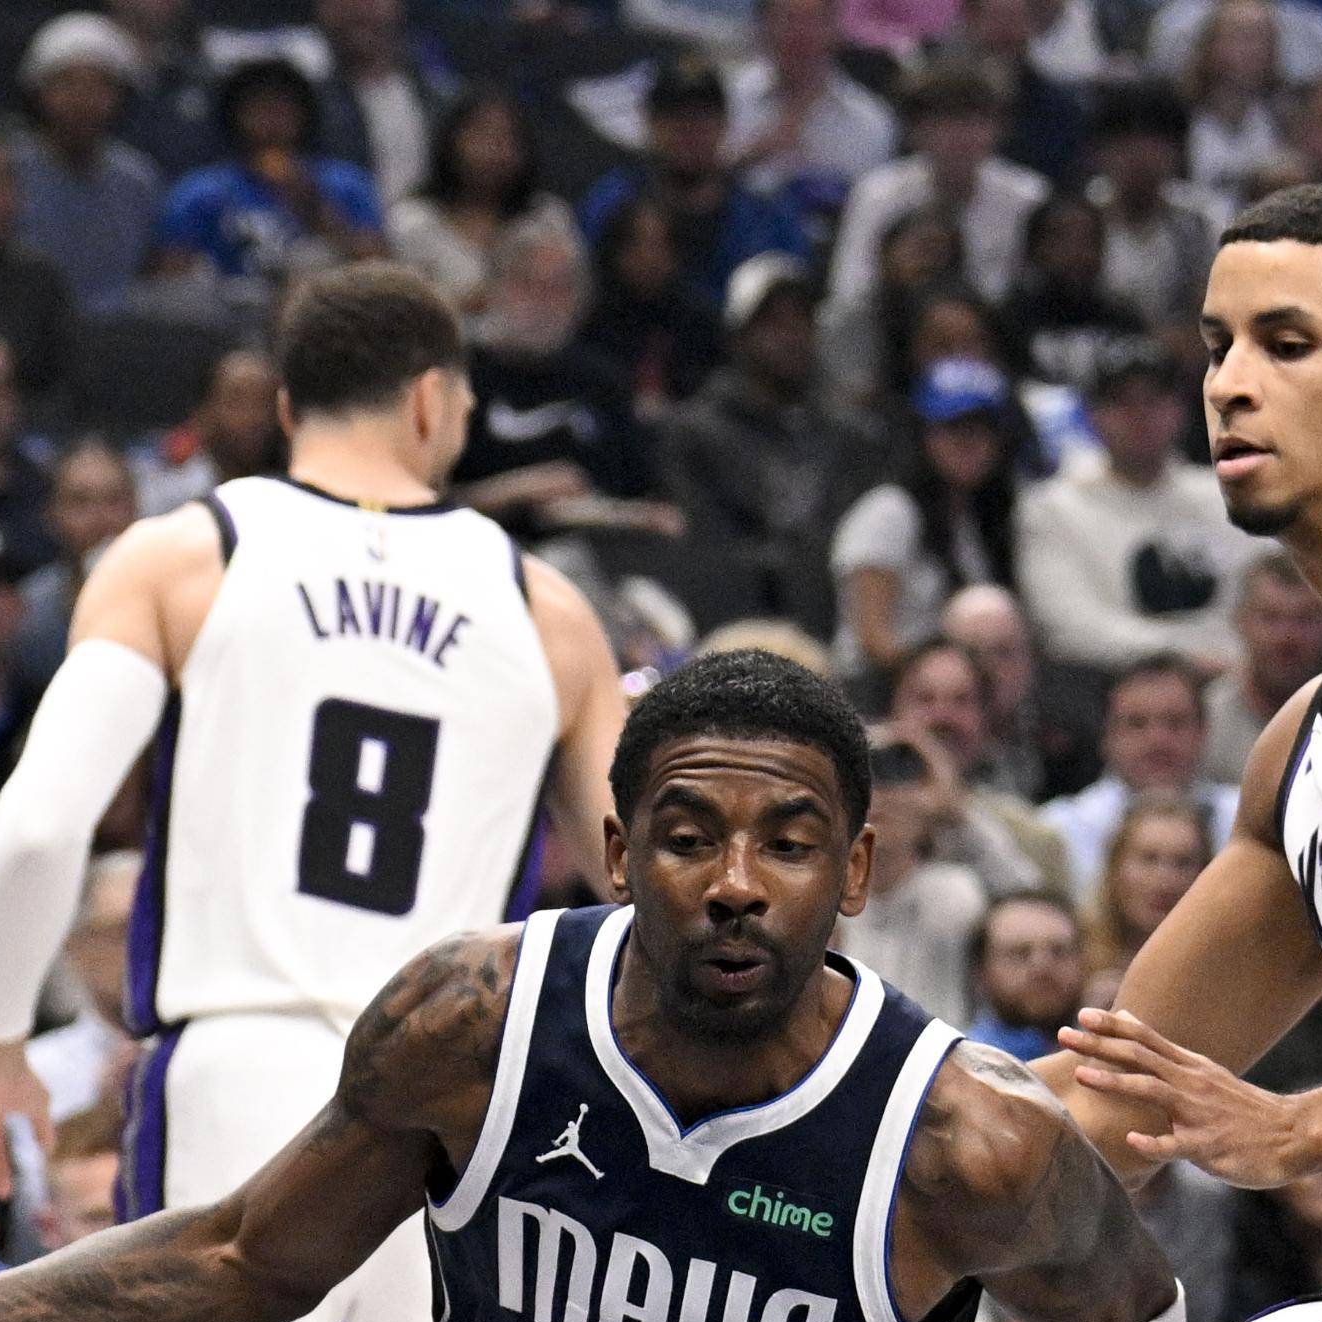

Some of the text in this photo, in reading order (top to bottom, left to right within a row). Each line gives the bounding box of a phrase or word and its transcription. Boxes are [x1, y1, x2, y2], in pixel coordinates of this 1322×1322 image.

[296, 577, 472, 668] LAVINE
[297, 697, 441, 917] 8
[727, 1184, 834, 1238] chime
